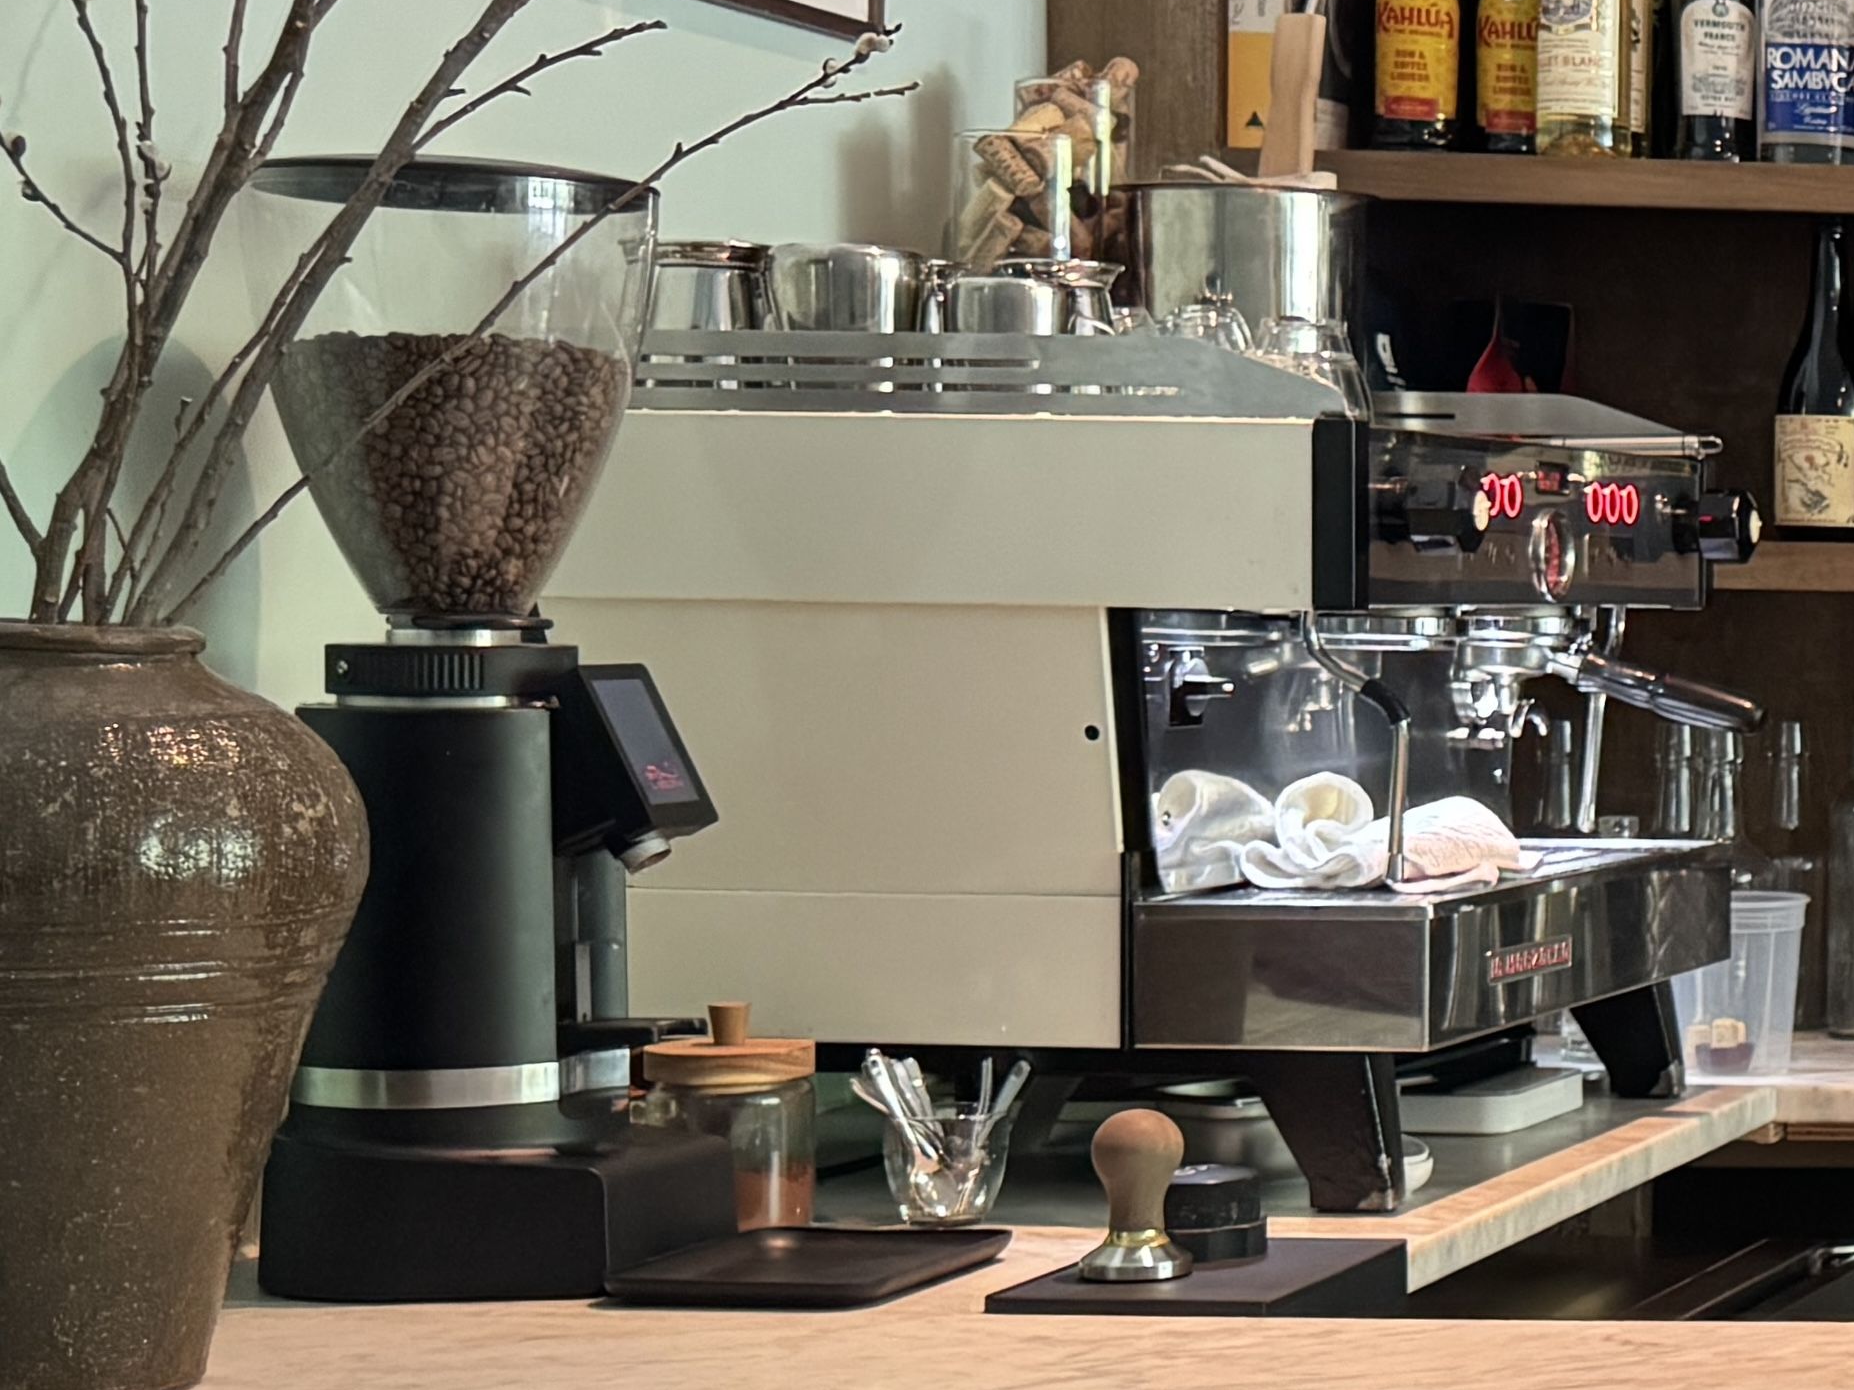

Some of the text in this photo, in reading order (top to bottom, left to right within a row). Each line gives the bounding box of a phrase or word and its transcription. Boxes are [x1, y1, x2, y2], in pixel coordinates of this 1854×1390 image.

[1378, 1, 1455, 39] KAHLÚA
[1477, 15, 1538, 48] KAHLÚ
[1694, 19, 1746, 31] VERMOUTH
